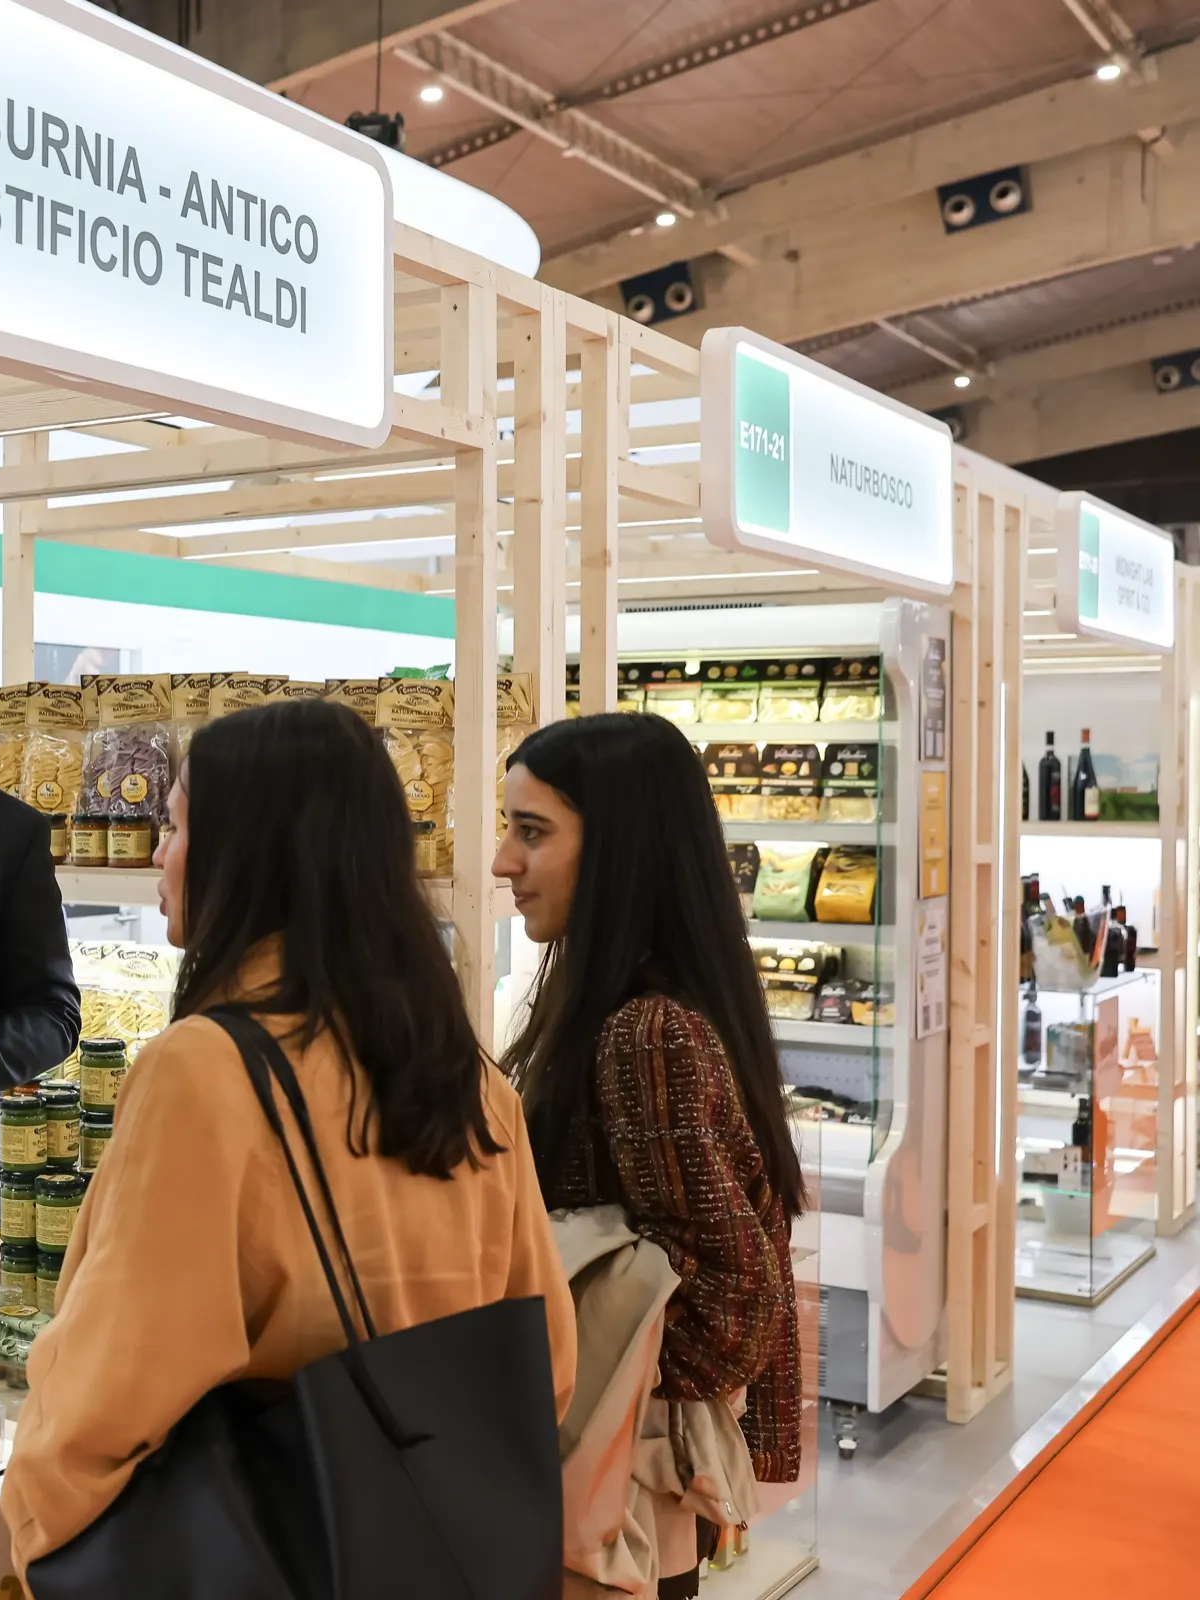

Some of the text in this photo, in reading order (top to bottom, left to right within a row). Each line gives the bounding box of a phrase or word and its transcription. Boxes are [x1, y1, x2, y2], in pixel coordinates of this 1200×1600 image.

[158, 184, 172, 200] -
[180, 170, 319, 264] ANTICO
[175, 242, 307, 334] TEALDI
[739, 420, 786, 462] E171-21
[829, 452, 914, 510] NATURBOSCO
